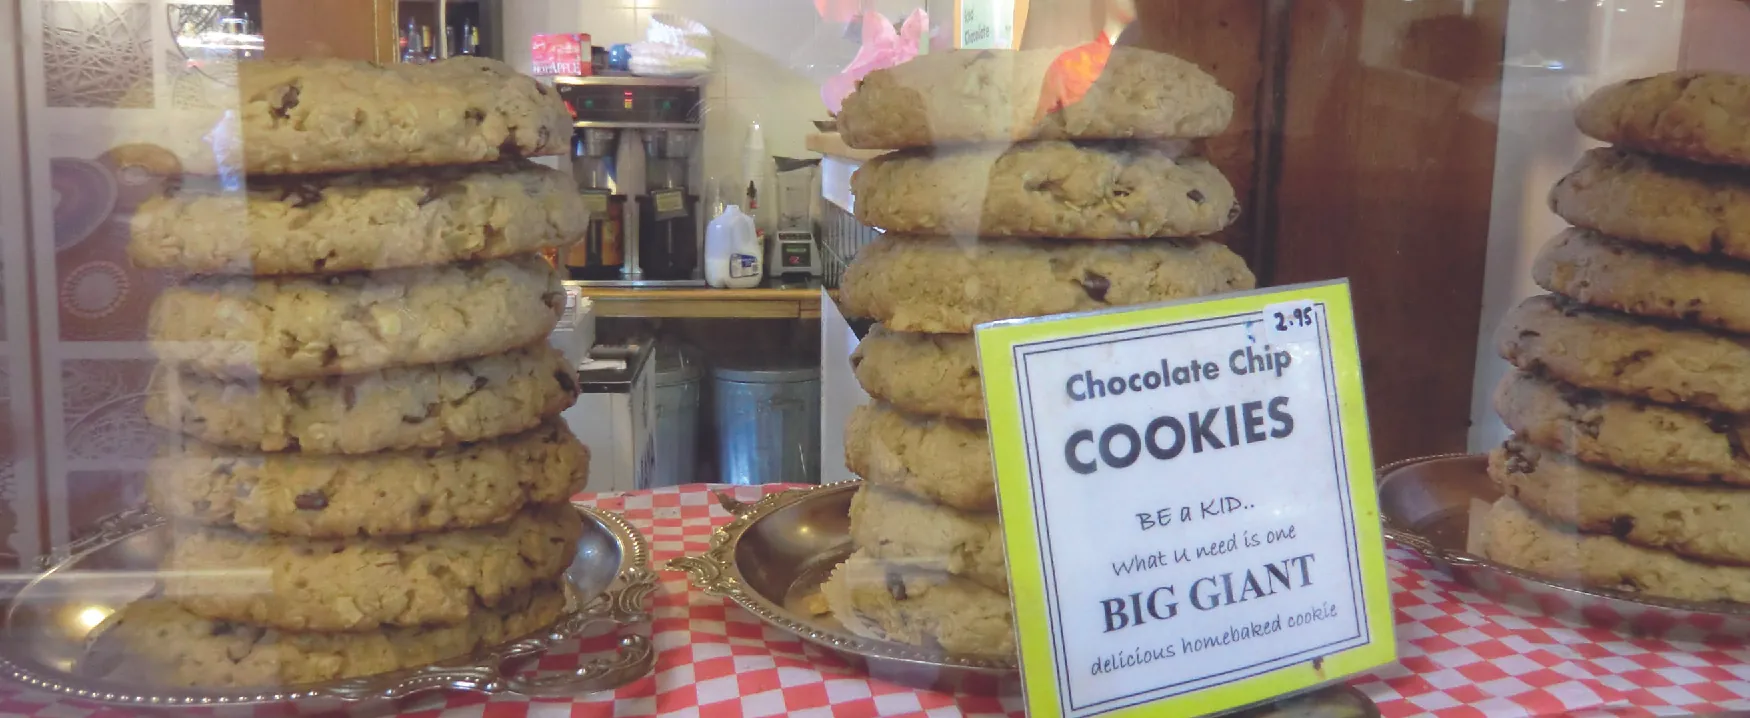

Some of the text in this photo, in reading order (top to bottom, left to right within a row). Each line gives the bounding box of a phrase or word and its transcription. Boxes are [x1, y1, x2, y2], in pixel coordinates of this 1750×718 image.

[550, 62, 581, 76] APPLE
[1273, 306, 1312, 332] 2.95
[1066, 345, 1292, 402] Chocolate Chip
[1064, 396, 1294, 475] COOKIES
[1136, 496, 1255, 531] BE a KID..
[1112, 550, 1168, 577] What
[1196, 533, 1239, 559] need
[1244, 530, 1261, 548] is
[1266, 523, 1297, 545] one
[1099, 553, 1316, 633] BIG GIANT
[1091, 602, 1338, 676] delicious homebaked cookie
